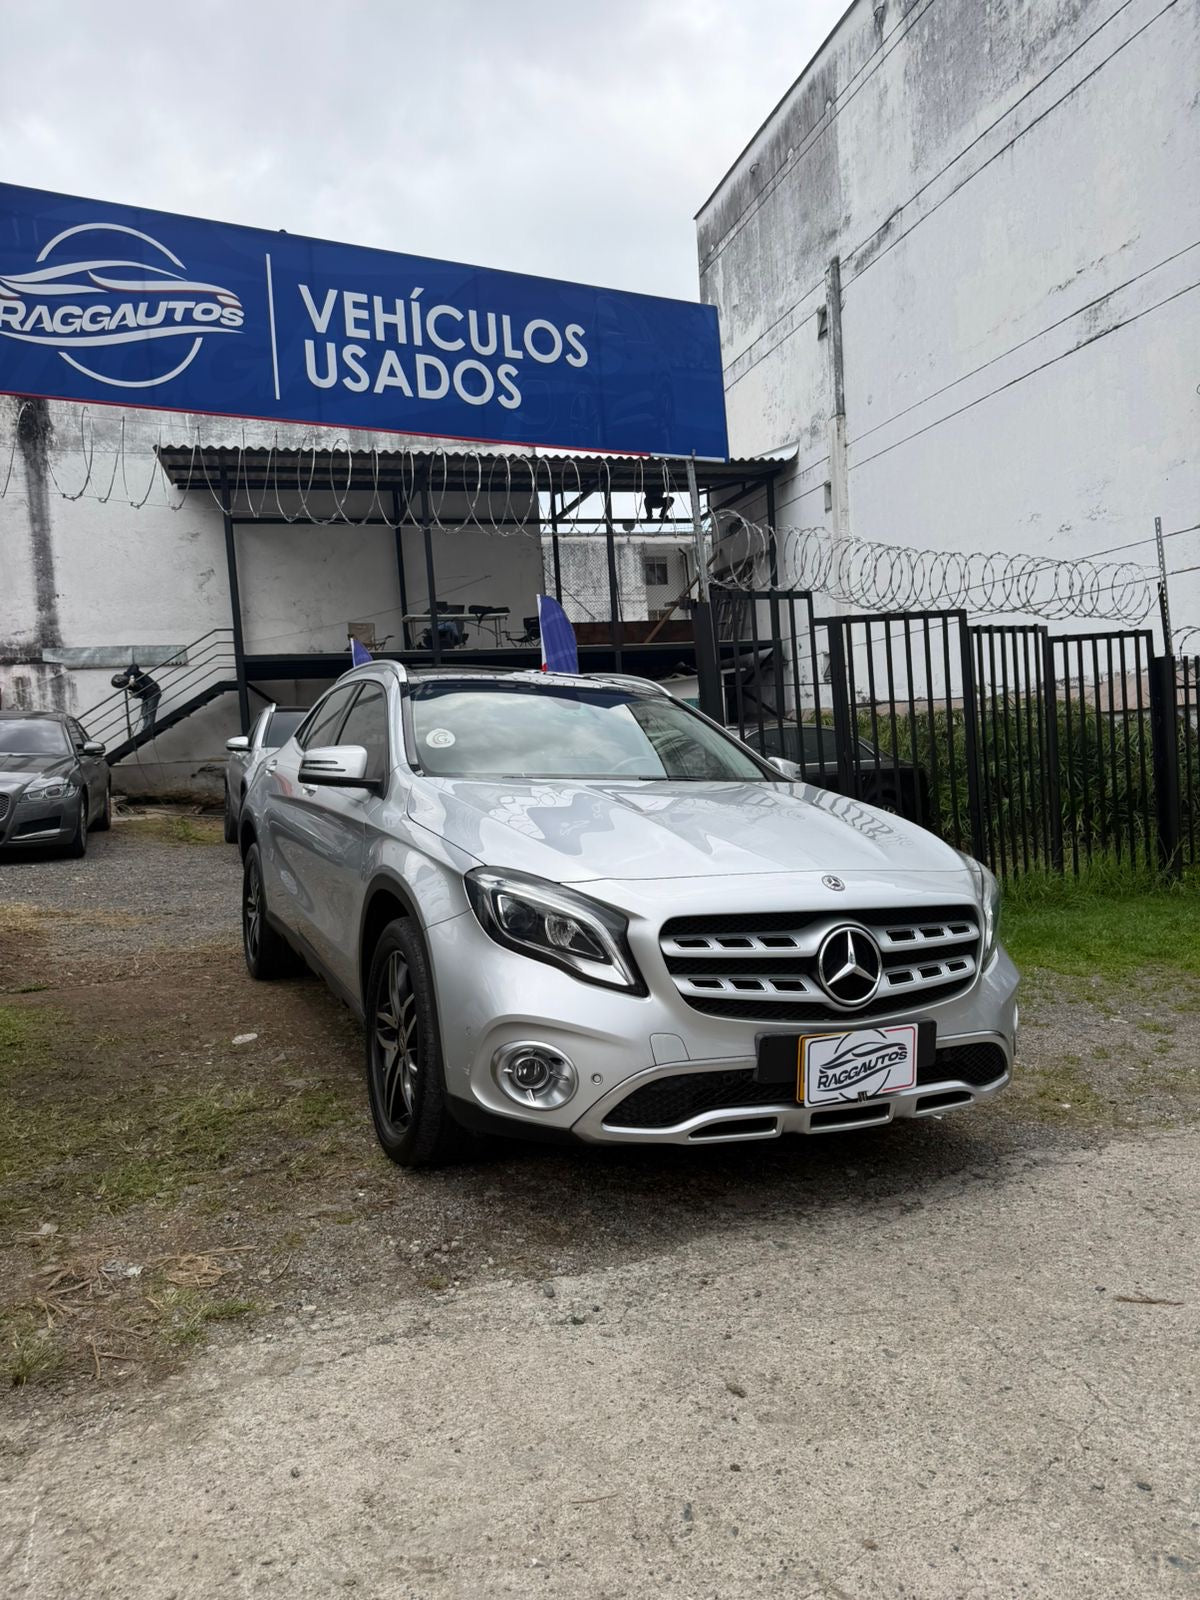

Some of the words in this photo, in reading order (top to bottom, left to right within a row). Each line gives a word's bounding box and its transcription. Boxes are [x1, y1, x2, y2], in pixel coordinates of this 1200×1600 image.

[0, 300, 245, 334] RAGGAUTOS
[298, 284, 588, 368] VEHÍCULOS
[304, 339, 522, 409] USADOS
[818, 1051, 908, 1089] RAGGAUTOS
